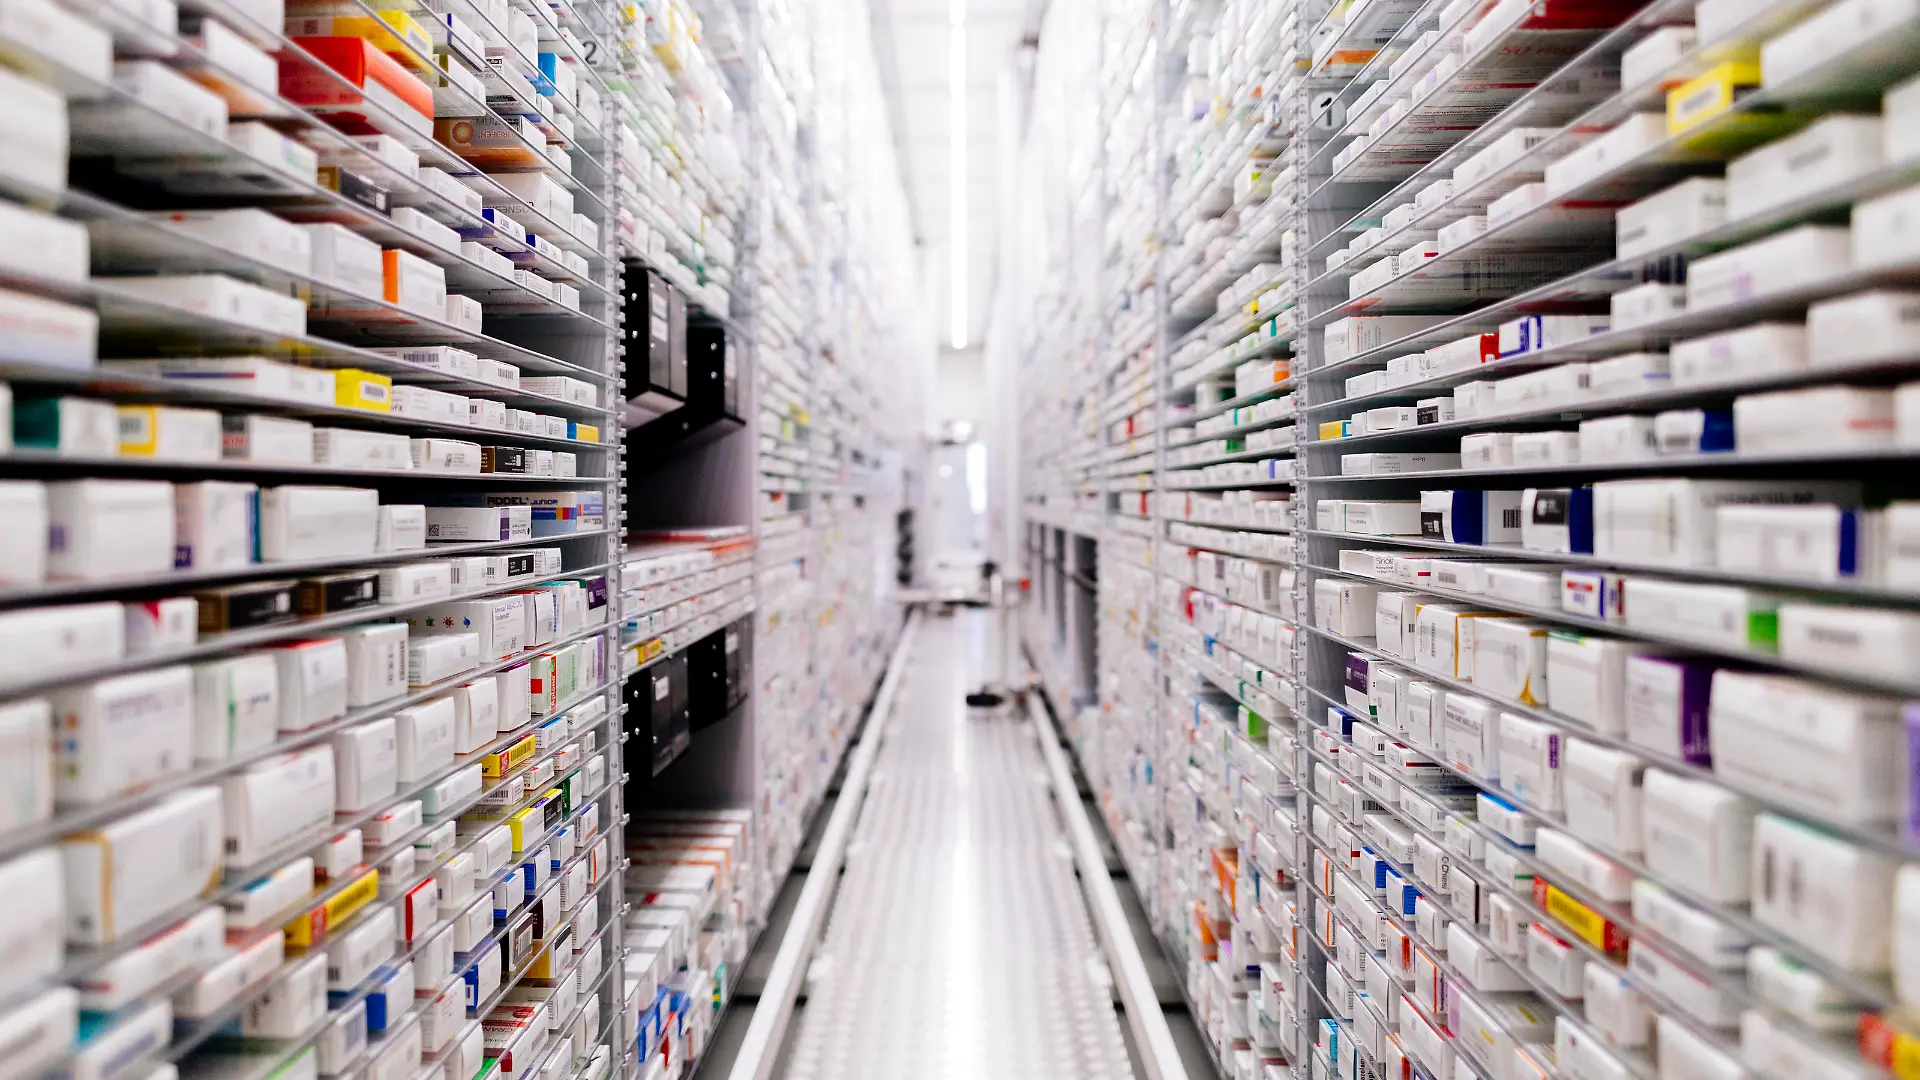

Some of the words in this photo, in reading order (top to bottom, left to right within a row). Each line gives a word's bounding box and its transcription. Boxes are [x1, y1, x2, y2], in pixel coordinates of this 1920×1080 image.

[583, 41, 597, 65] 2
[1320, 97, 1332, 126] 1
[1442, 864, 1450, 889] Chiesi
